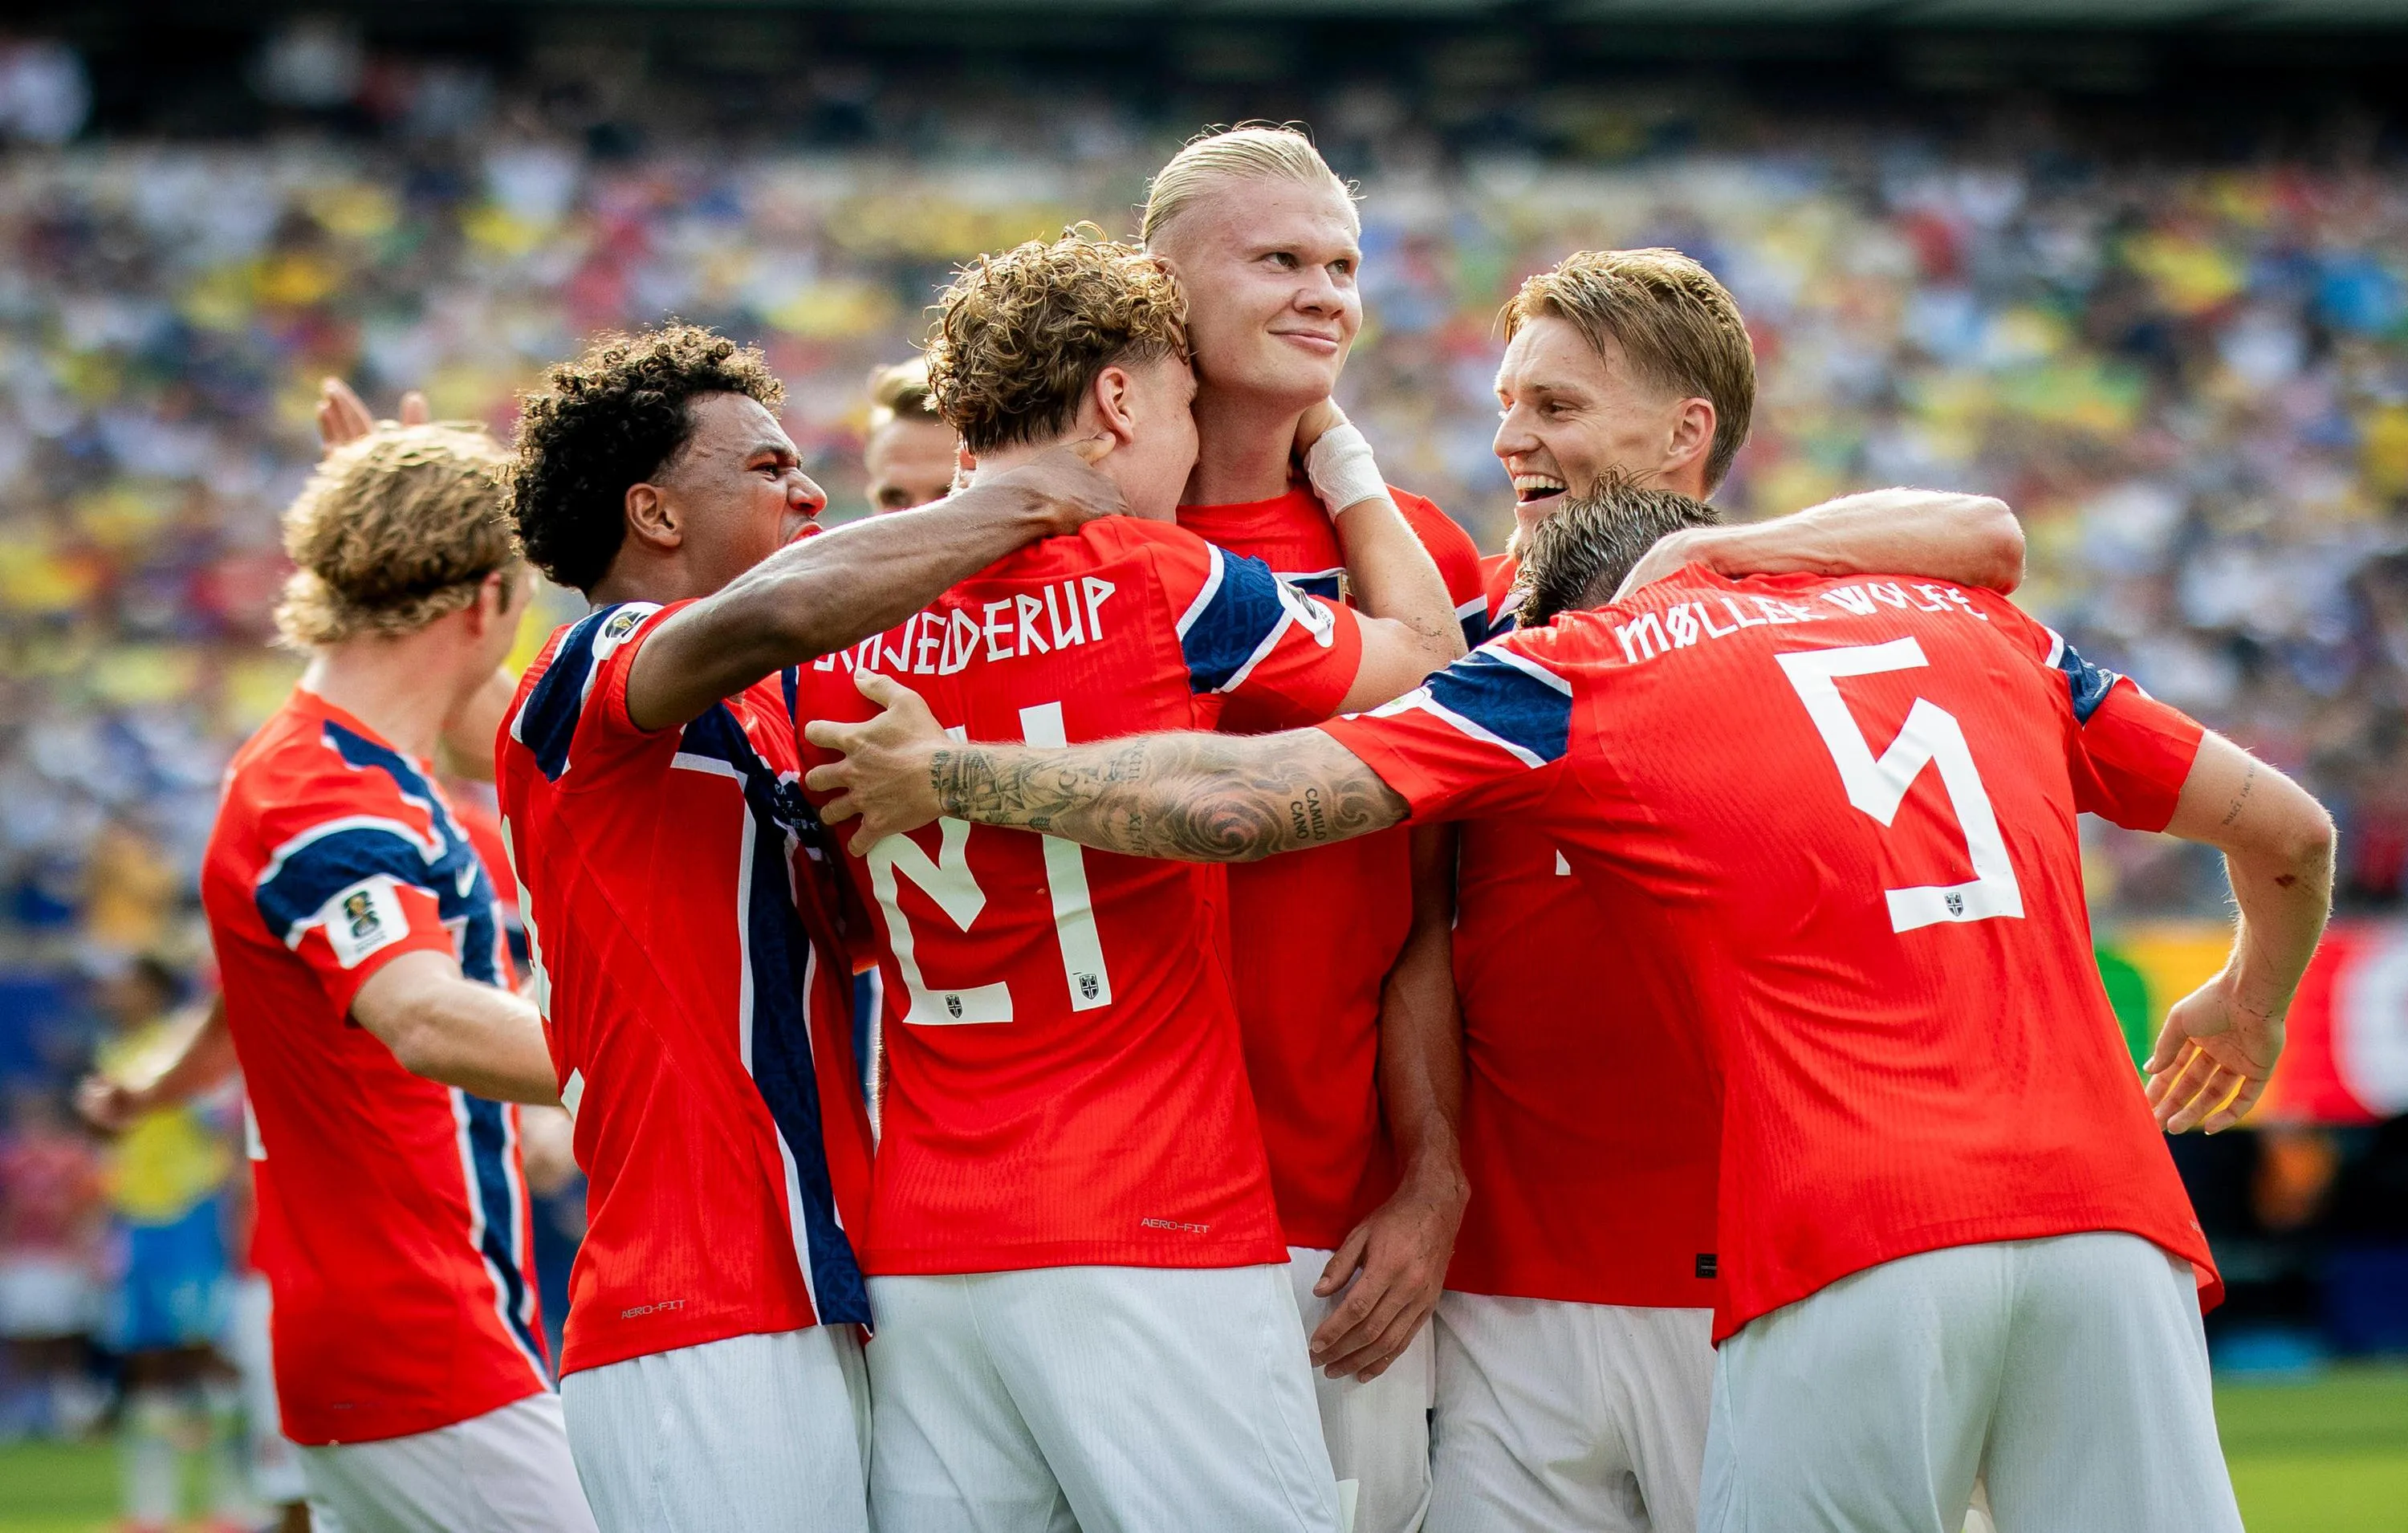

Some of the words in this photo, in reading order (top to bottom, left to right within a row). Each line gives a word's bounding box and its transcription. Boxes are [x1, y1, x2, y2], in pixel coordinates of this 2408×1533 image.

[813, 576, 1116, 675] HJELDERUP
[1615, 596, 1828, 664] MØLLER
[1305, 788, 1327, 840] CAMILO
[1773, 636, 2025, 933] 5
[1291, 801, 1309, 839] CANO
[867, 701, 1112, 1025] 21
[1141, 1218, 1210, 1234] AERO-FIT
[621, 1299, 685, 1320] AERO-FIT
